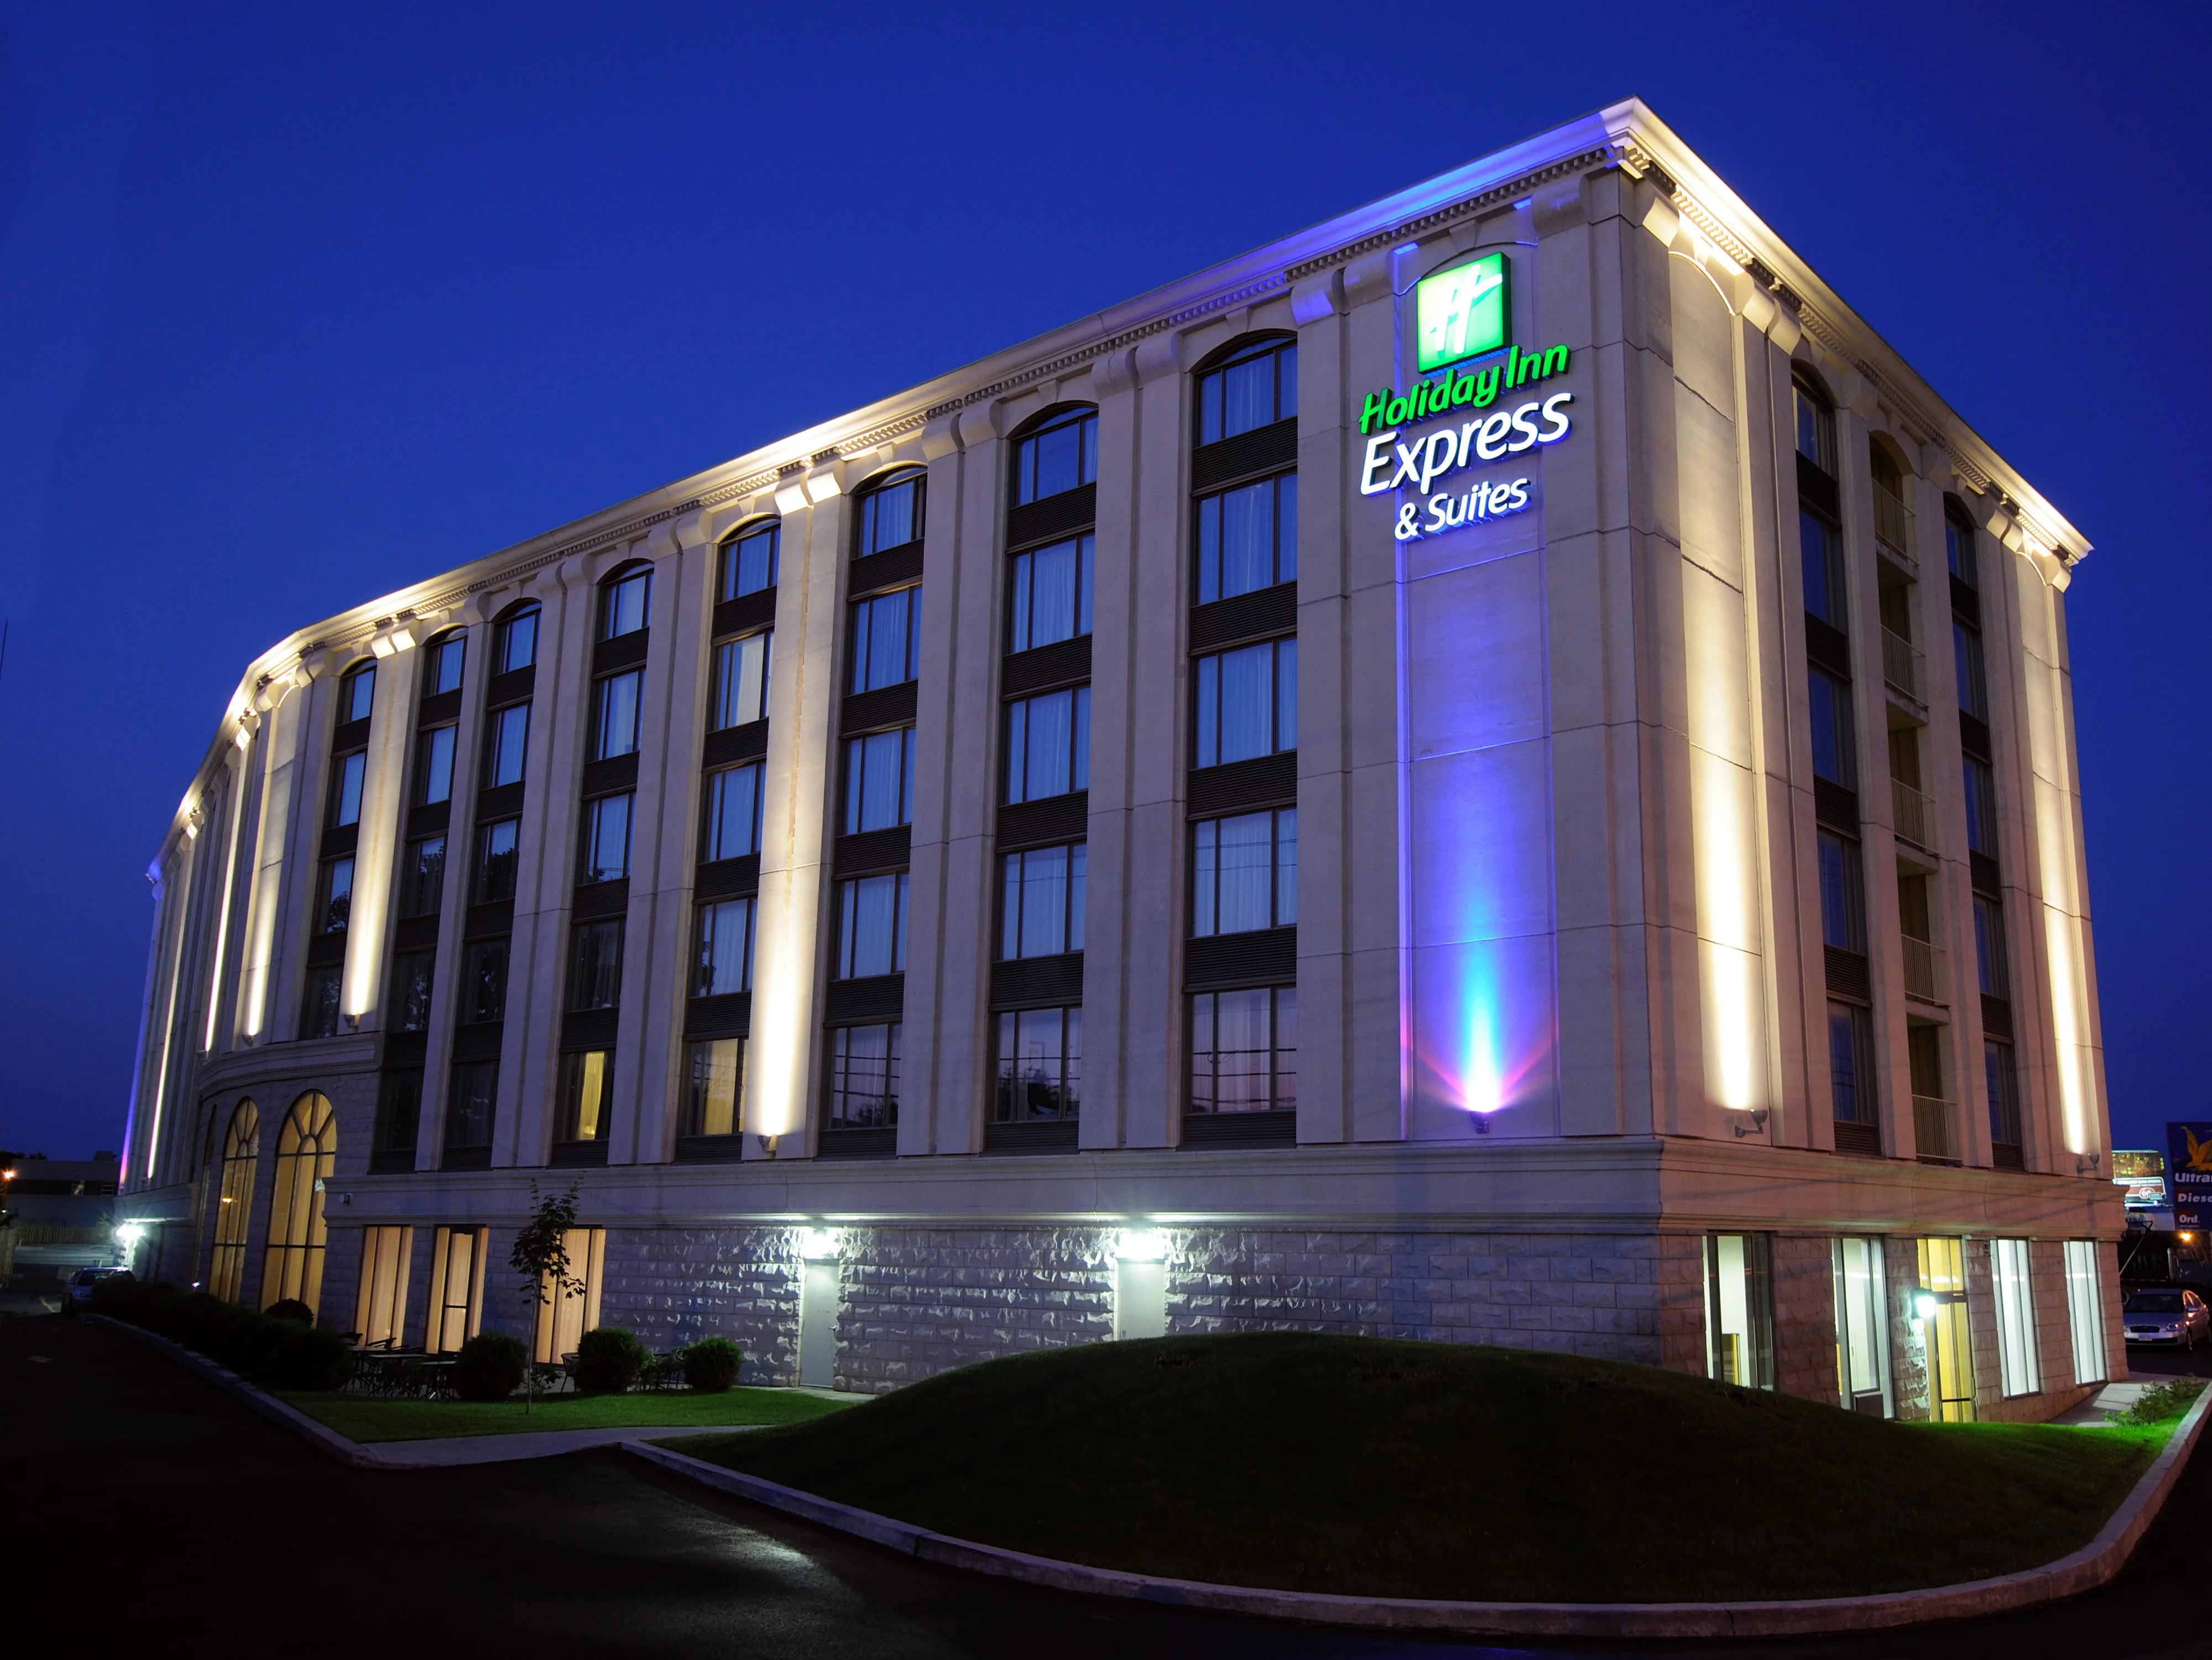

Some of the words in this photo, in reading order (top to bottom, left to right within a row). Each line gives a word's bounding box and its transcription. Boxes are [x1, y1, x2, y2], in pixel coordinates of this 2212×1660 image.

[1358, 365, 1504, 435] Holiday
[1506, 344, 1569, 388] Inn
[1360, 392, 1573, 495] Express
[1394, 502, 1418, 540] &
[1425, 478, 1530, 532] Suites
[2174, 1172, 2212, 1183] Ultra
